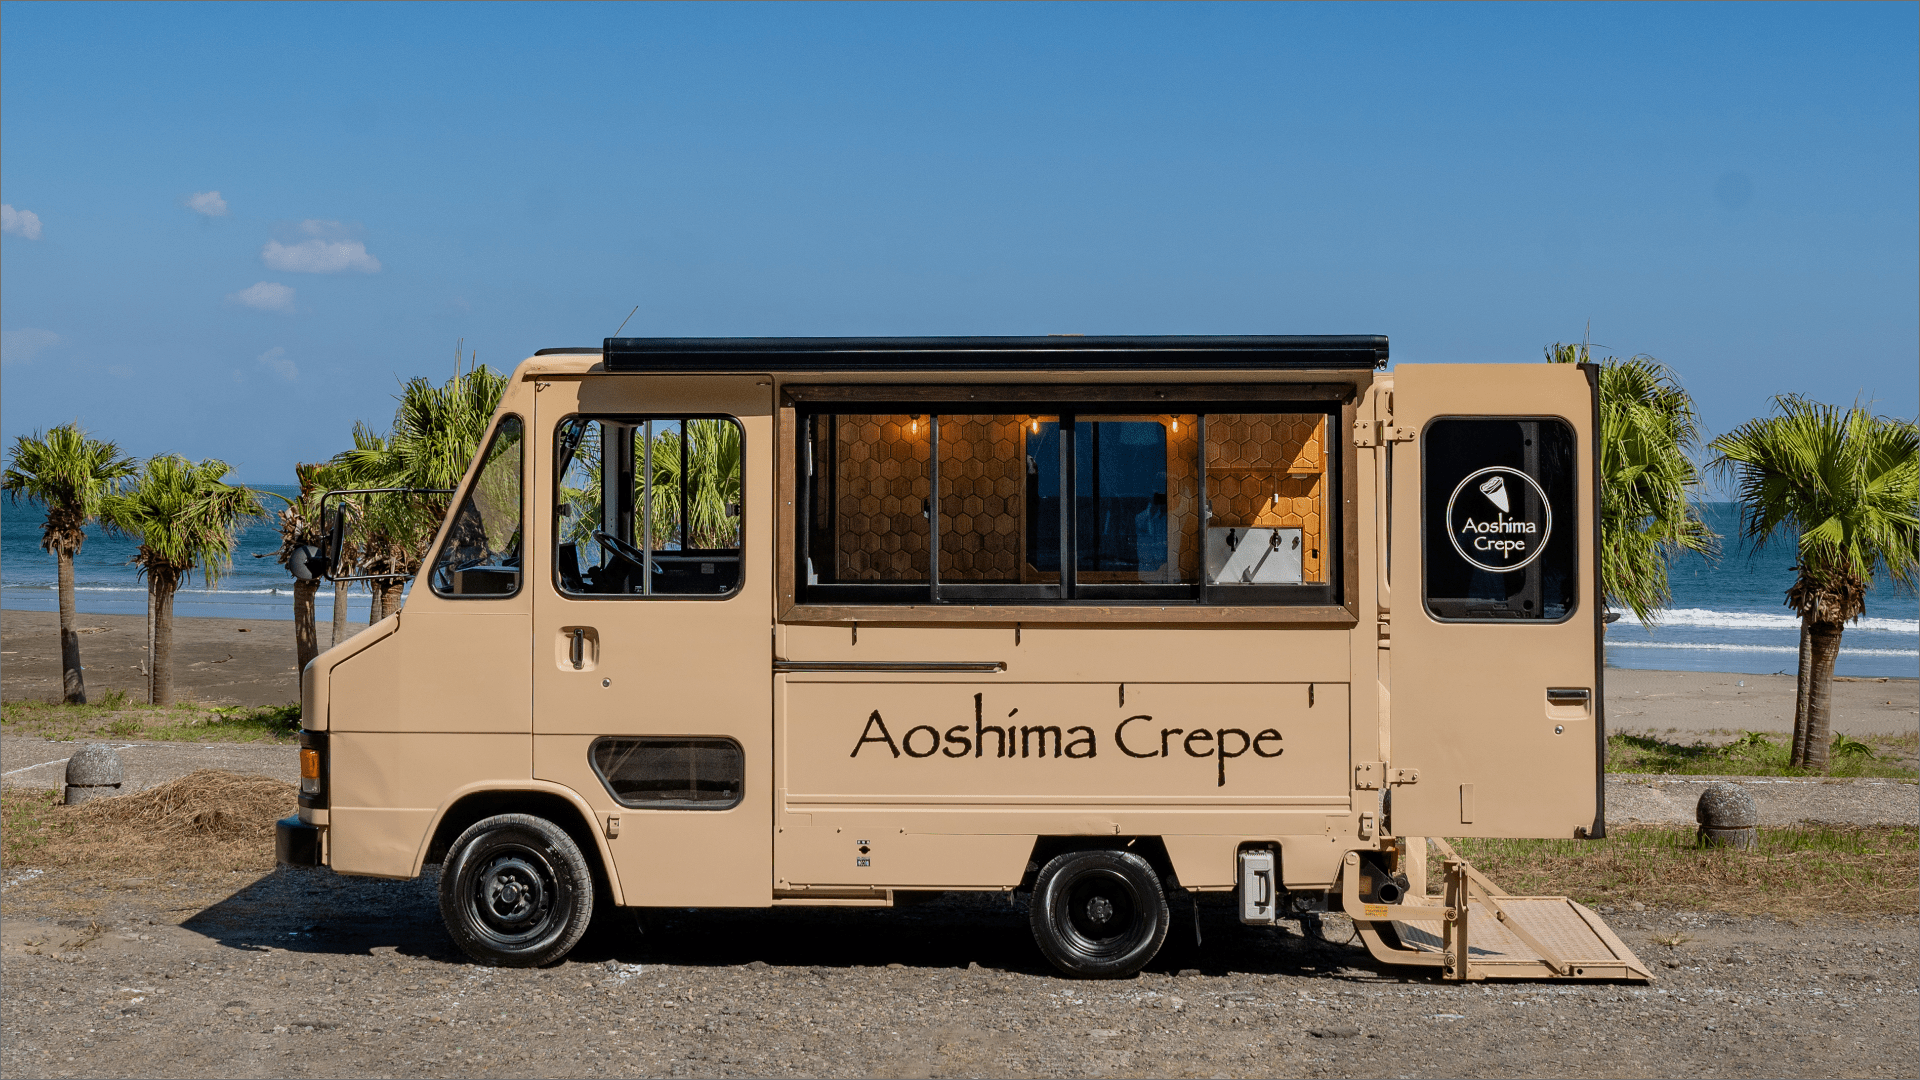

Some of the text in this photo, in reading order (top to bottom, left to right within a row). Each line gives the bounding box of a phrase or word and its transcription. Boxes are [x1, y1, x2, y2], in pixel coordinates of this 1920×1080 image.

[1462, 512, 1537, 534] Aoshima
[1474, 536, 1525, 559] Crepe
[850, 692, 1284, 787] Aoshima Crepe
